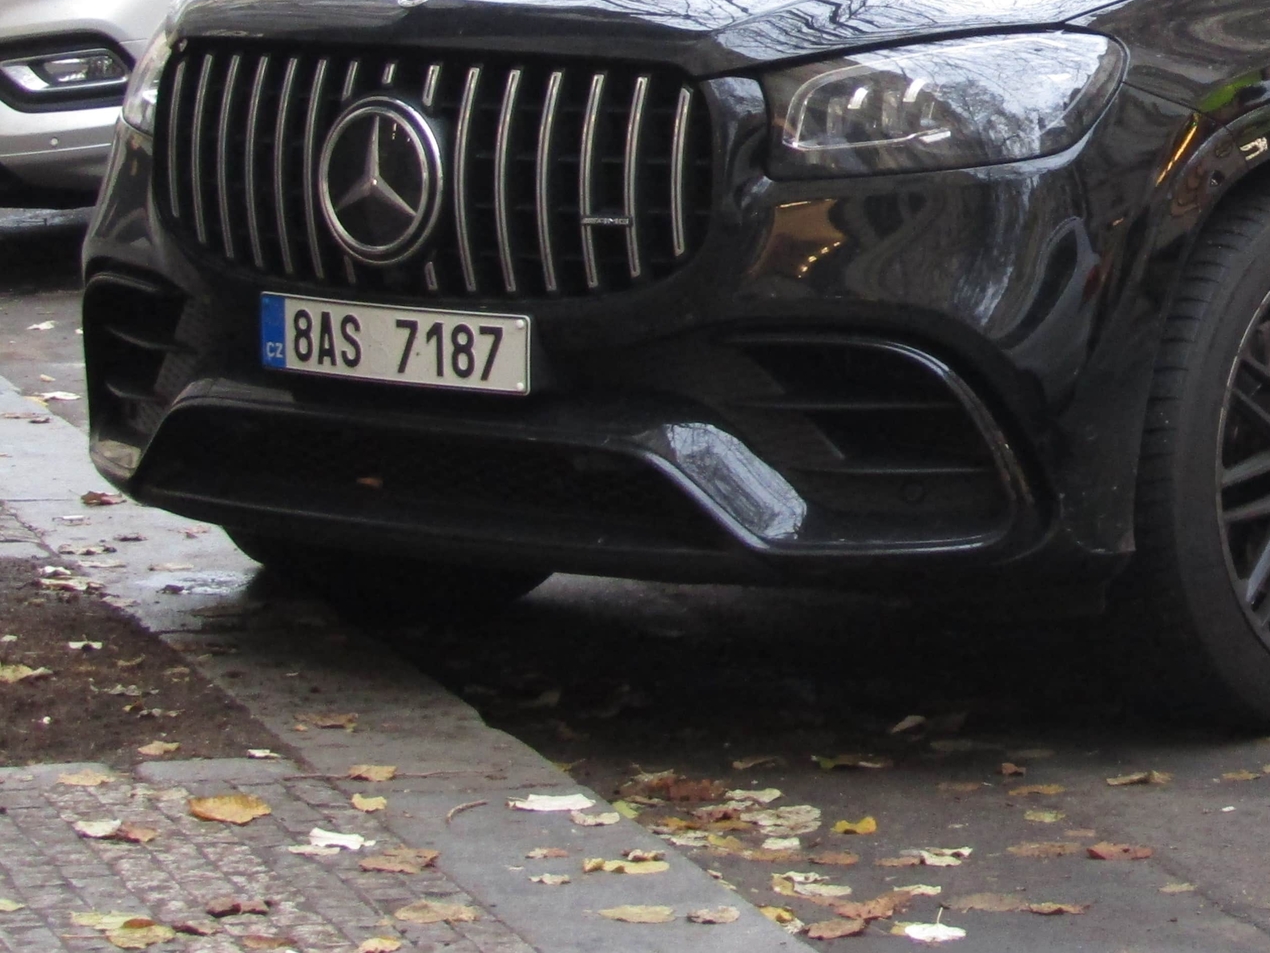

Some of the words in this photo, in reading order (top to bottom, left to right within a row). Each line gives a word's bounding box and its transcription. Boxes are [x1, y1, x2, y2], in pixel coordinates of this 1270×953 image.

[266, 342, 284, 359] CZ
[293, 309, 362, 368] 8AS
[396, 318, 503, 381] 7187
